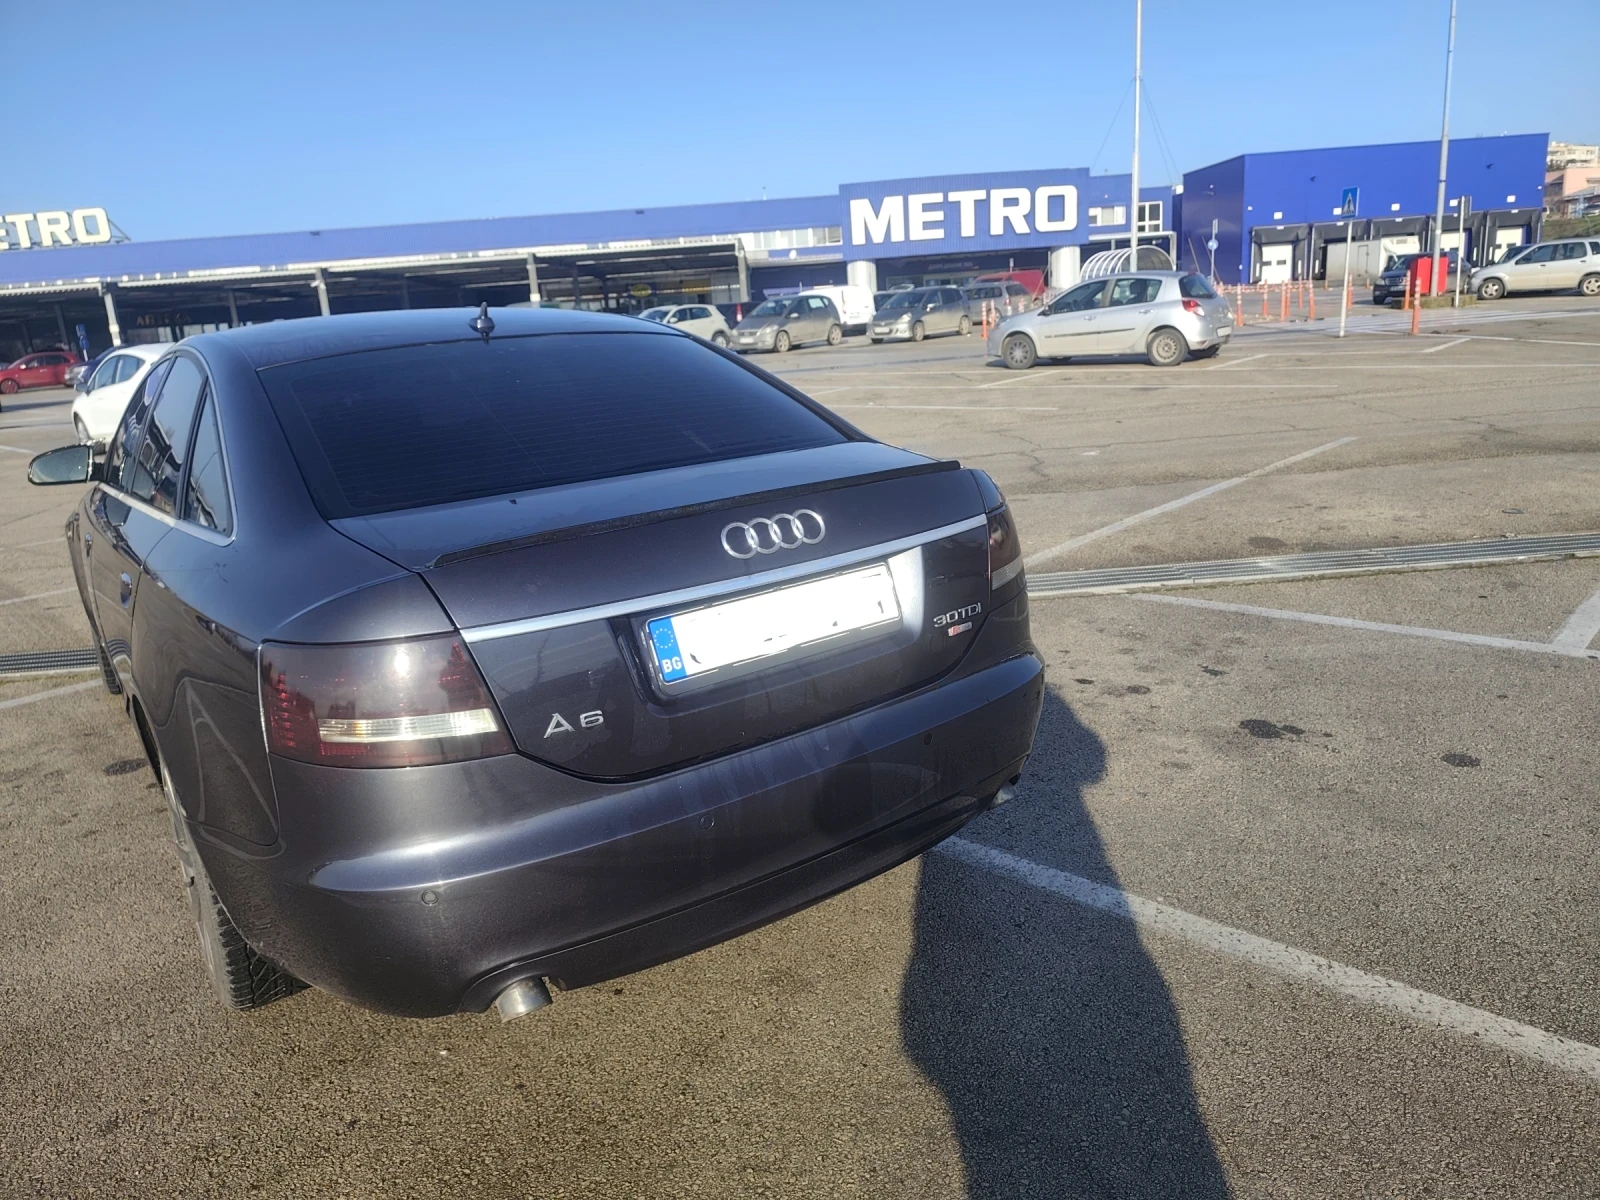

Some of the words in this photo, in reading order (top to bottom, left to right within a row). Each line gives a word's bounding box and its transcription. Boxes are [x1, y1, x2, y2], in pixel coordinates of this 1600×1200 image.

[0, 207, 111, 250] TRO
[849, 184, 1078, 246] METRO
[662, 656, 682, 673] BG
